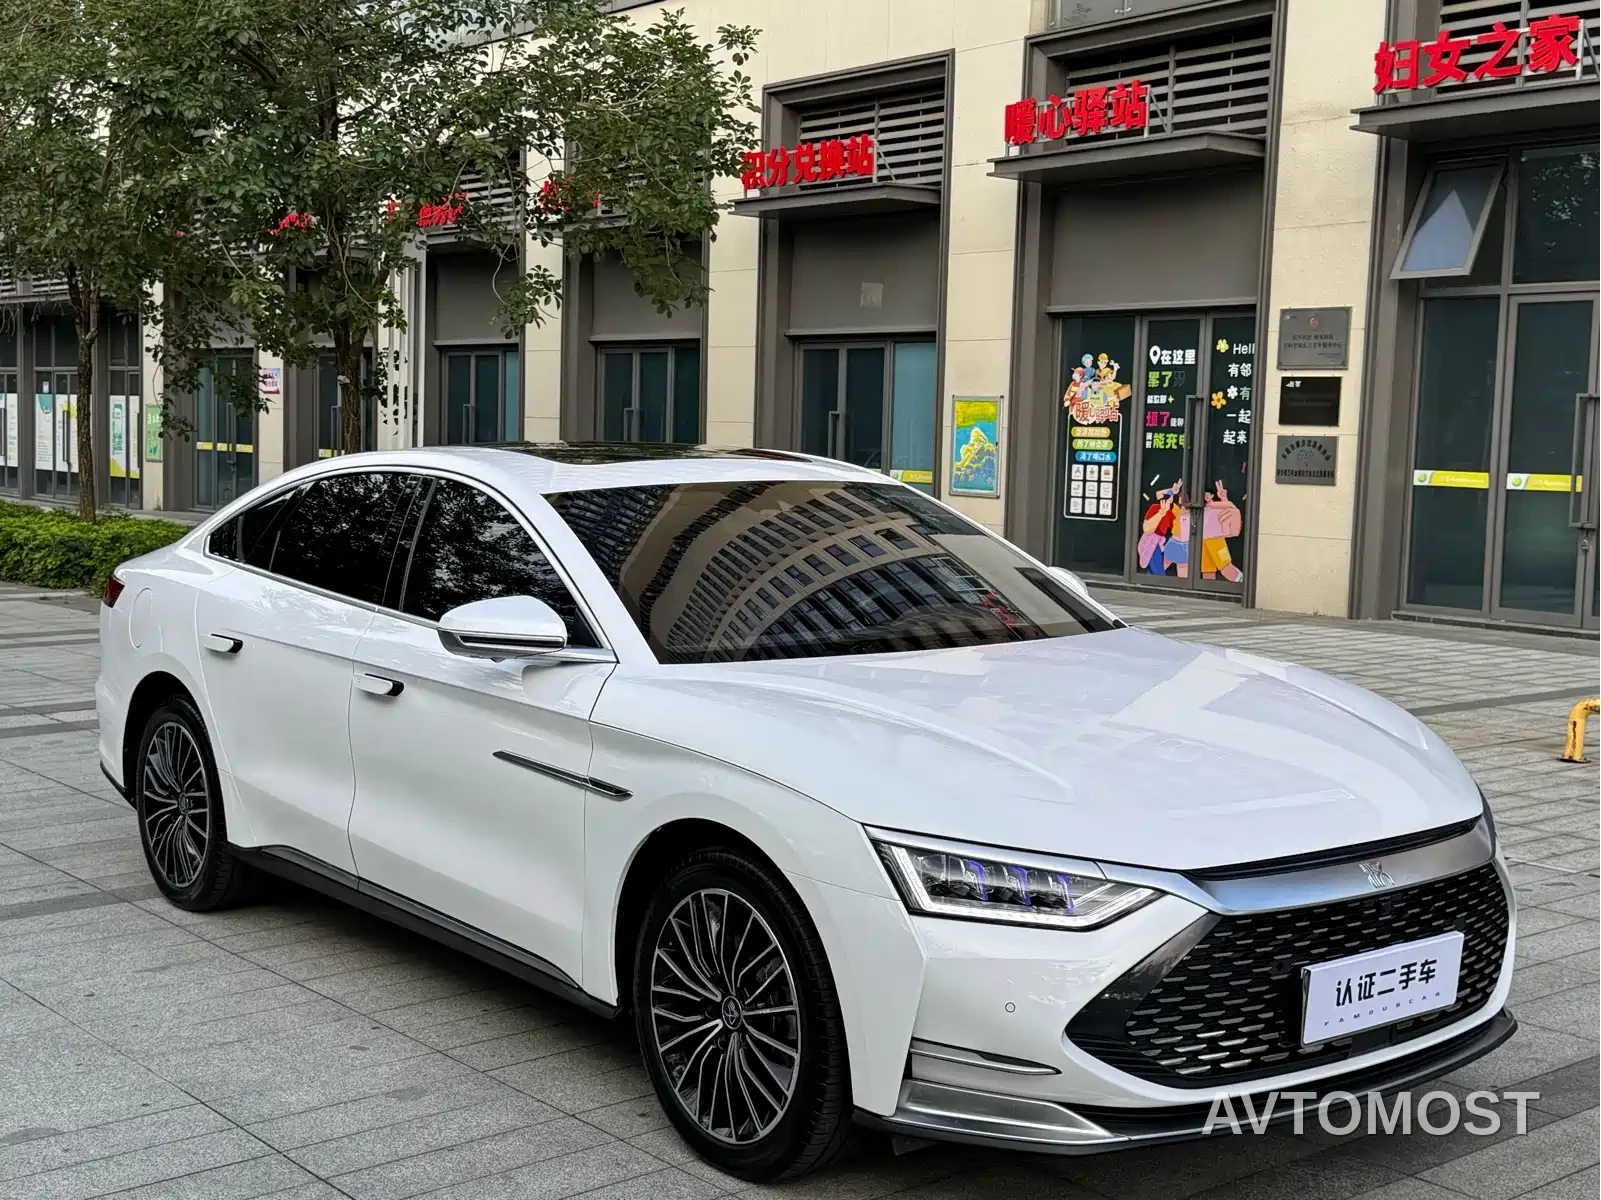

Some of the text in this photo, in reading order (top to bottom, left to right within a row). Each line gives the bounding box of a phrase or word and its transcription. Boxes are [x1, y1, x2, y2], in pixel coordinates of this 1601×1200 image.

[1373, 13, 1581, 95] 妇女之家
[1004, 79, 1149, 145] 暖心驿站
[740, 133, 874, 190] 积分兑换站
[1160, 349, 1196, 365] 在这里
[1239, 386, 1251, 400] 有
[1226, 408, 1252, 424] 一起
[1222, 429, 1248, 445] 起来
[1335, 958, 1437, 1007] 认证二手车
